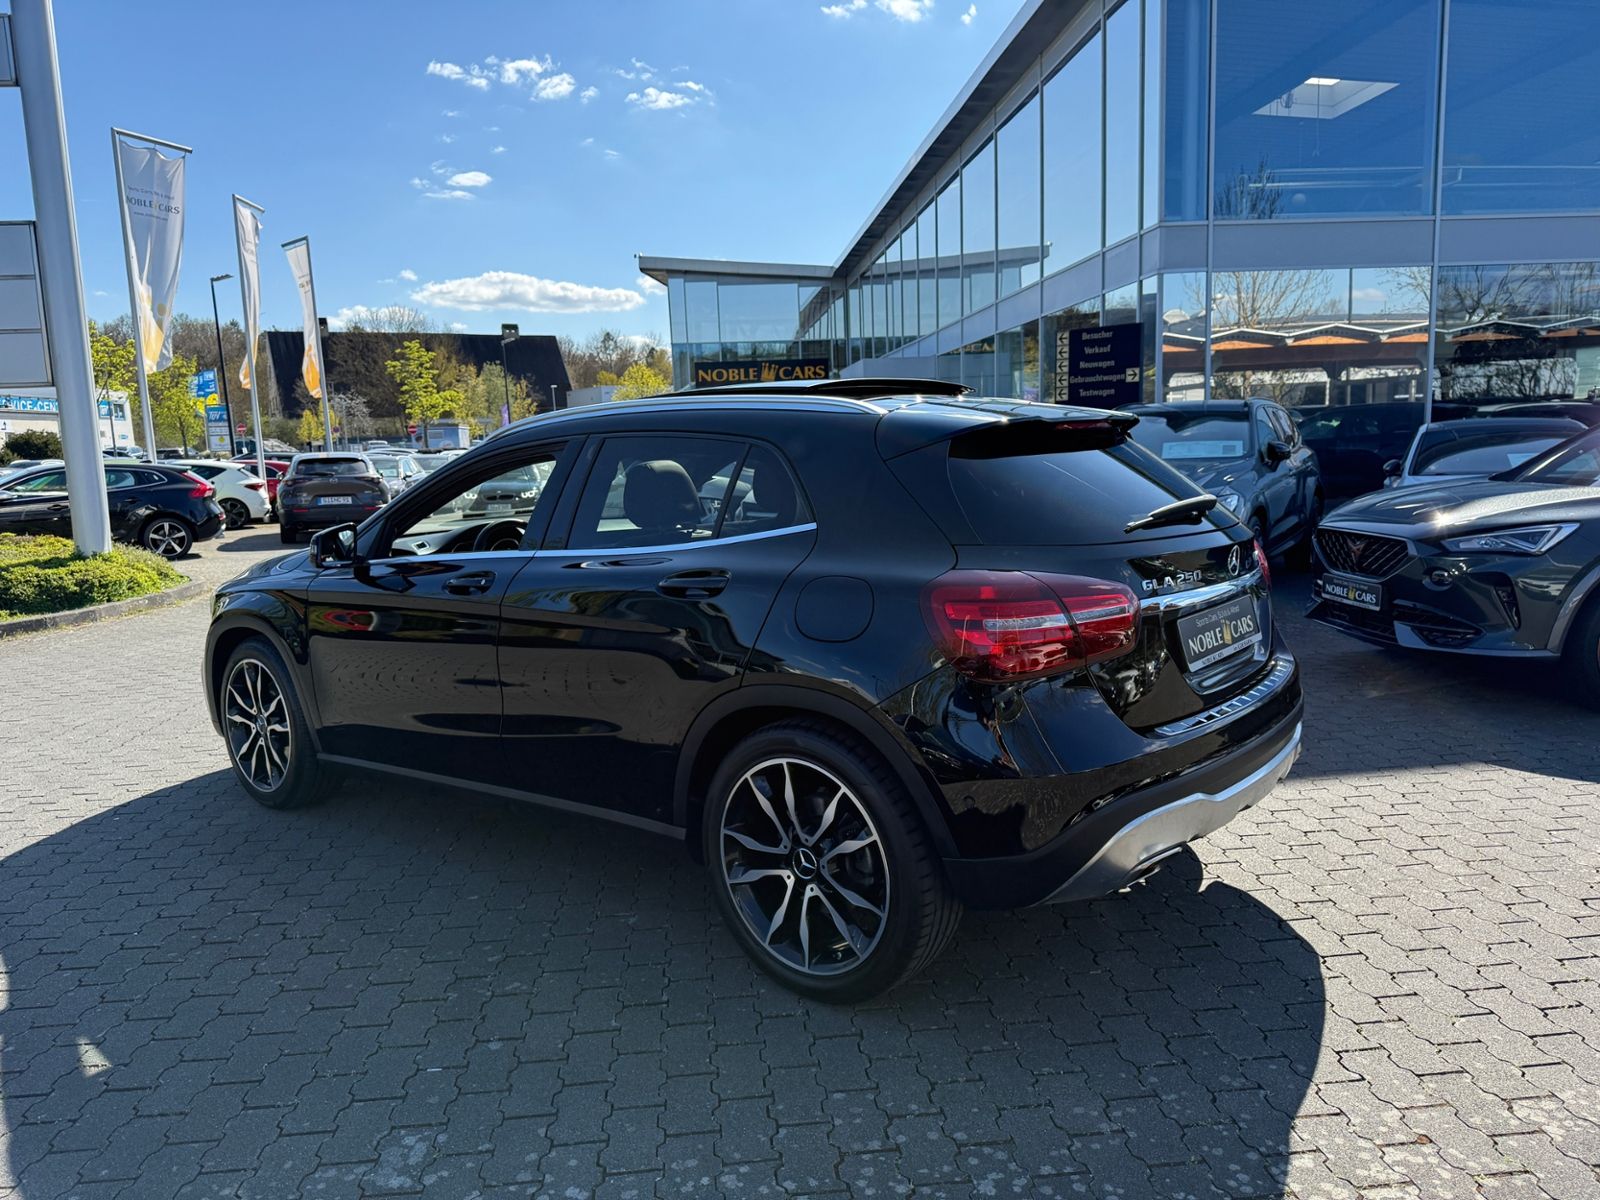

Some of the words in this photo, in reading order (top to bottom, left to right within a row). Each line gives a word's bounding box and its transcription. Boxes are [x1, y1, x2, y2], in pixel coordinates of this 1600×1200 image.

[1082, 331, 1113, 340] Besucher
[1084, 344, 1112, 354] Verkauf
[1080, 360, 1115, 369] Neuwagen
[698, 368, 758, 382] NOBLE
[779, 365, 826, 380] CARS
[1070, 373, 1125, 384] Gebrauchtwagen
[1079, 389, 1115, 397] Testwagen
[1142, 576, 1175, 591] GLA
[1176, 570, 1202, 585] 250
[1325, 584, 1348, 597] NOBLE
[1355, 591, 1376, 604] CARS
[1188, 626, 1224, 656] NOBLE
[1230, 614, 1254, 638] CARS
